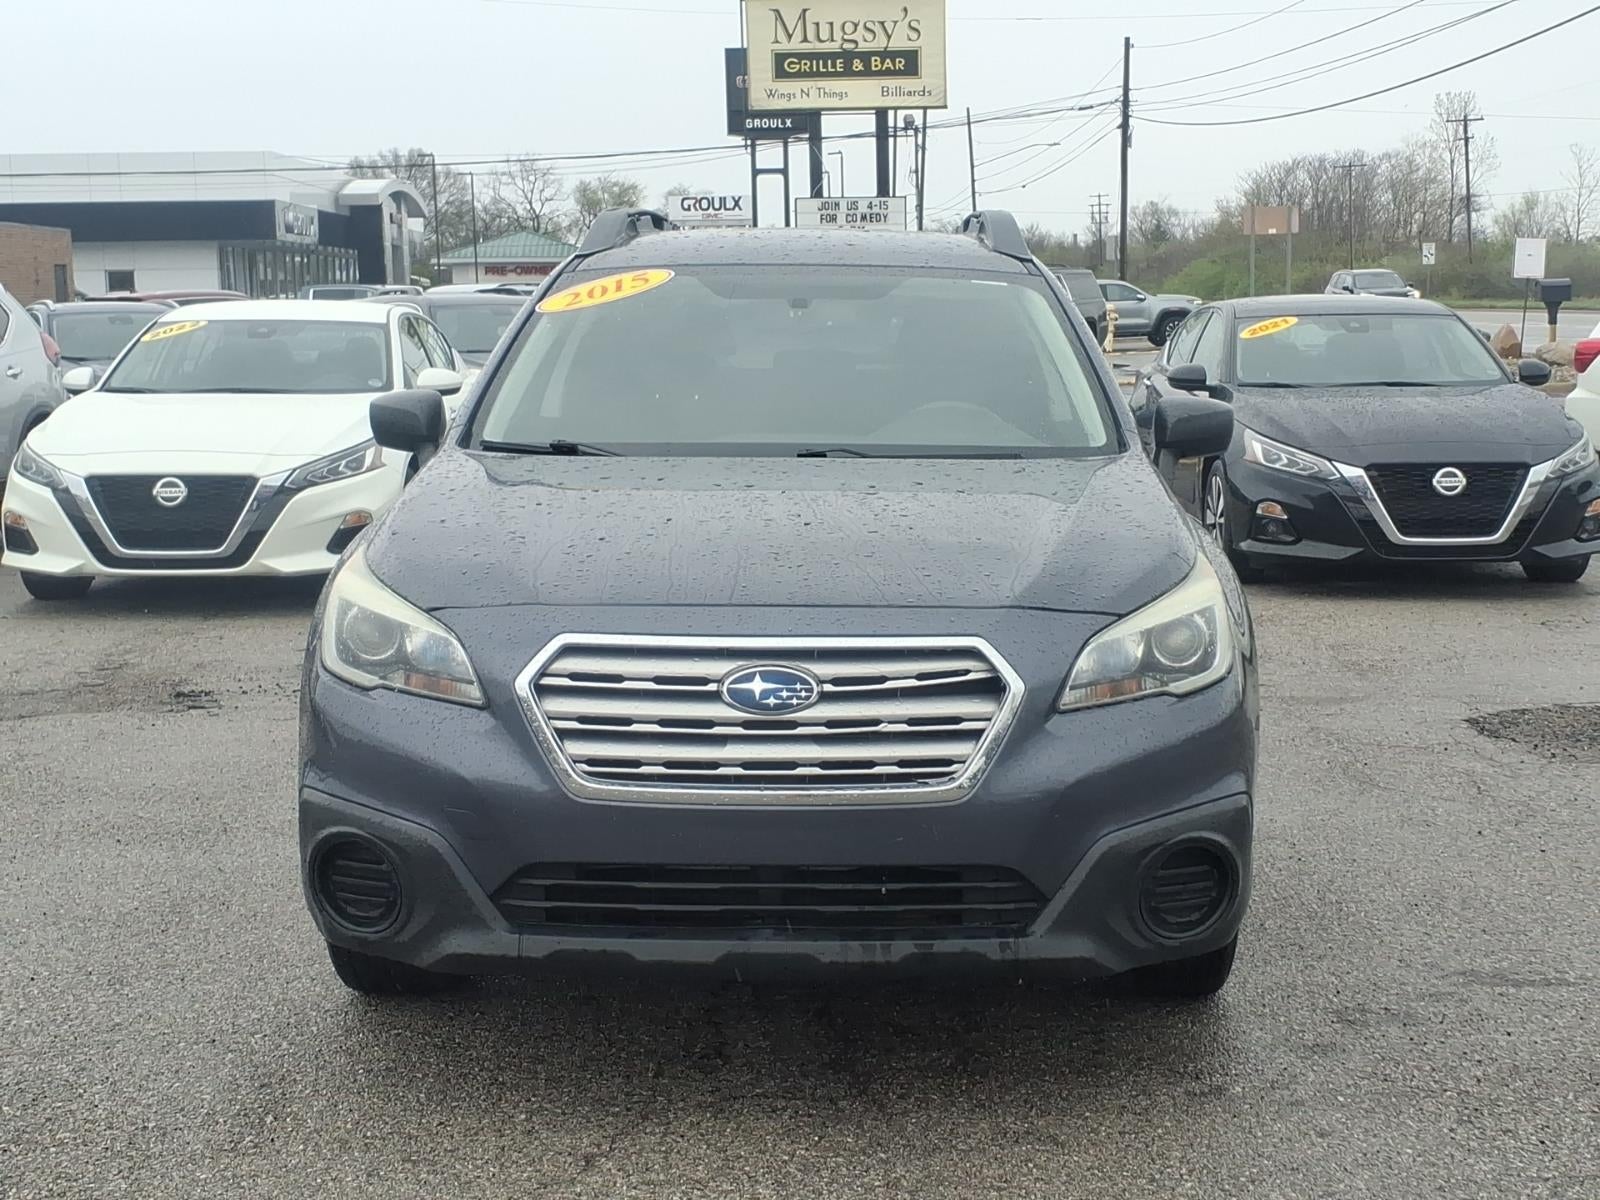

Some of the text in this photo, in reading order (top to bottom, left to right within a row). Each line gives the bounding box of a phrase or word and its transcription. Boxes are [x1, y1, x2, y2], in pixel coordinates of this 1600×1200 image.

[769, 6, 921, 51] Mugsy's
[783, 56, 906, 73] GRILLE & BAR
[764, 88, 797, 101] Wings
[816, 87, 849, 101] Things
[881, 85, 933, 97] Billiards
[745, 118, 793, 128] GROULX
[680, 195, 743, 212] GROULX
[817, 200, 889, 211] JOIN US 4-15
[820, 213, 838, 224] FOR
[564, 272, 650, 307] 2015
[1247, 318, 1290, 336] 2021
